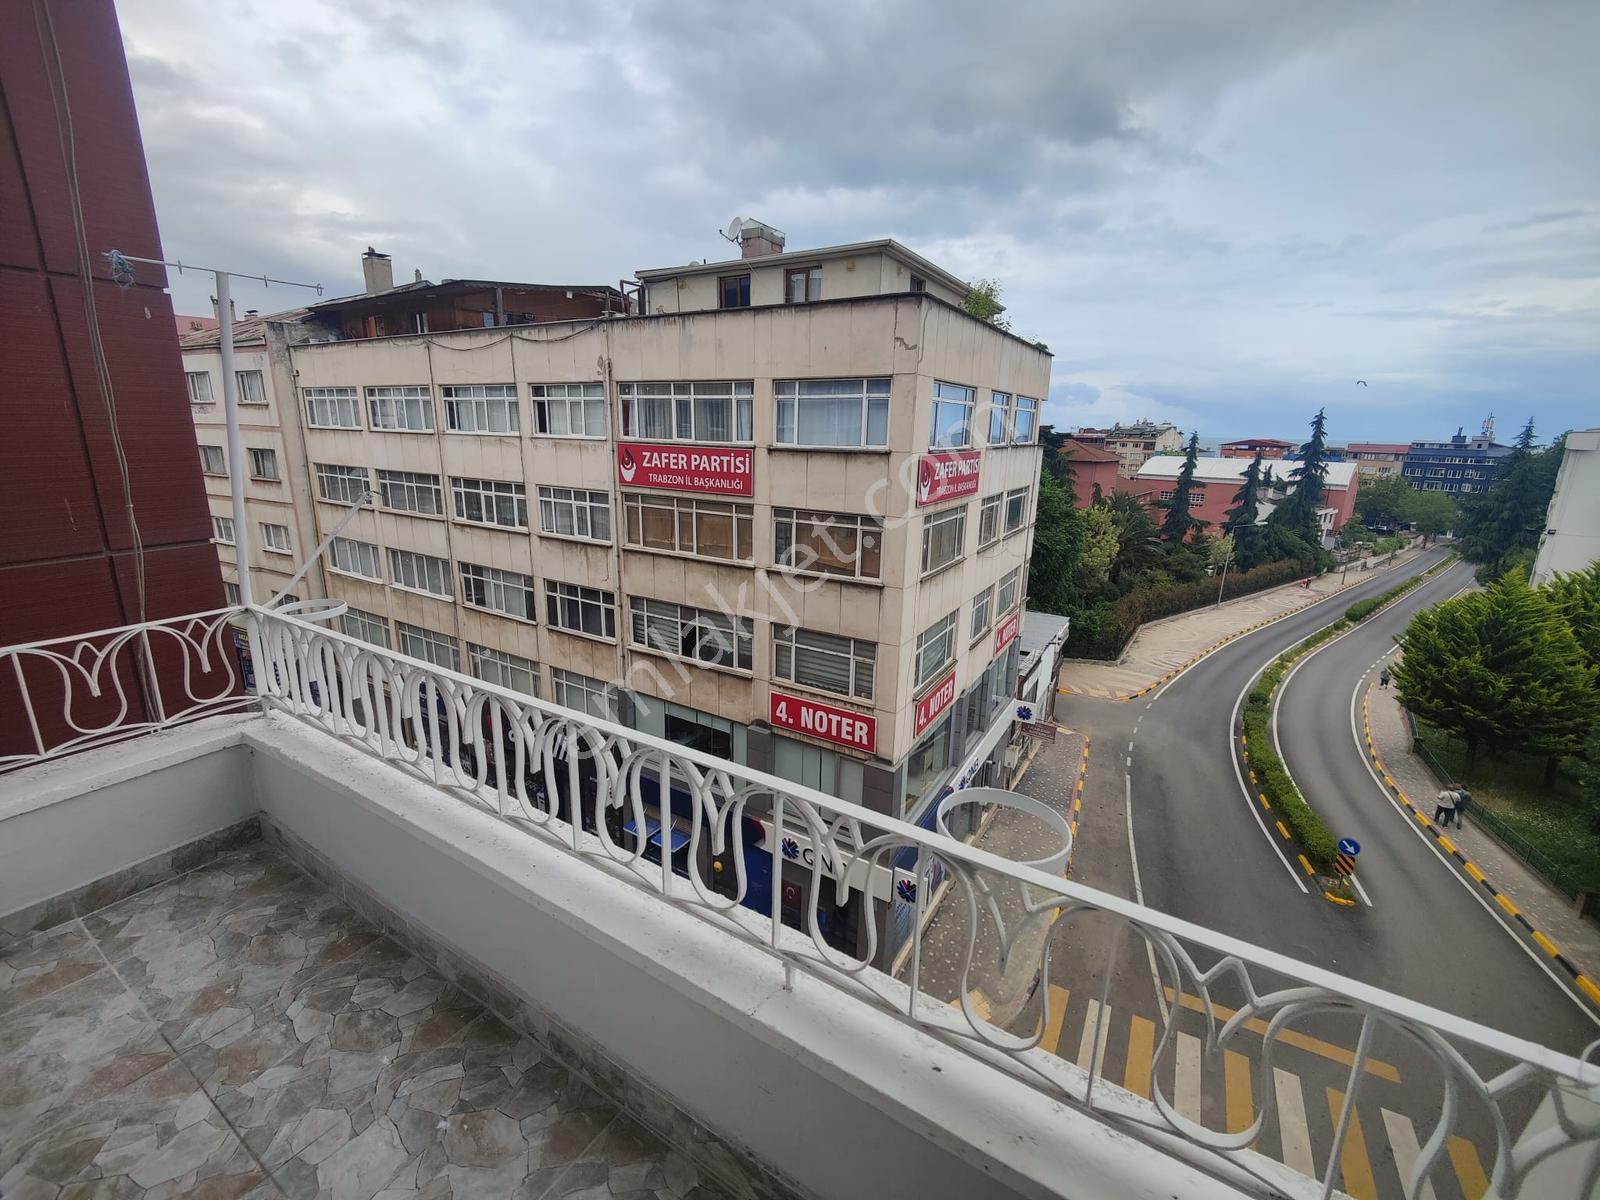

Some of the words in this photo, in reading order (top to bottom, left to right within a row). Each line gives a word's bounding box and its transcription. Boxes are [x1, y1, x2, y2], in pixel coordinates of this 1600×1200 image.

[642, 451, 688, 470] ZAFER
[690, 453, 750, 474] PARTİSİ
[934, 460, 958, 481] ZAFER
[648, 473, 684, 485] TRABZON
[685, 474, 693, 486] İL
[694, 477, 743, 490] BAŞKANLIĞI
[919, 706, 927, 727] 4.
[929, 680, 954, 719] NOTER
[776, 701, 793, 724] 4.
[800, 706, 868, 745] NOTER
